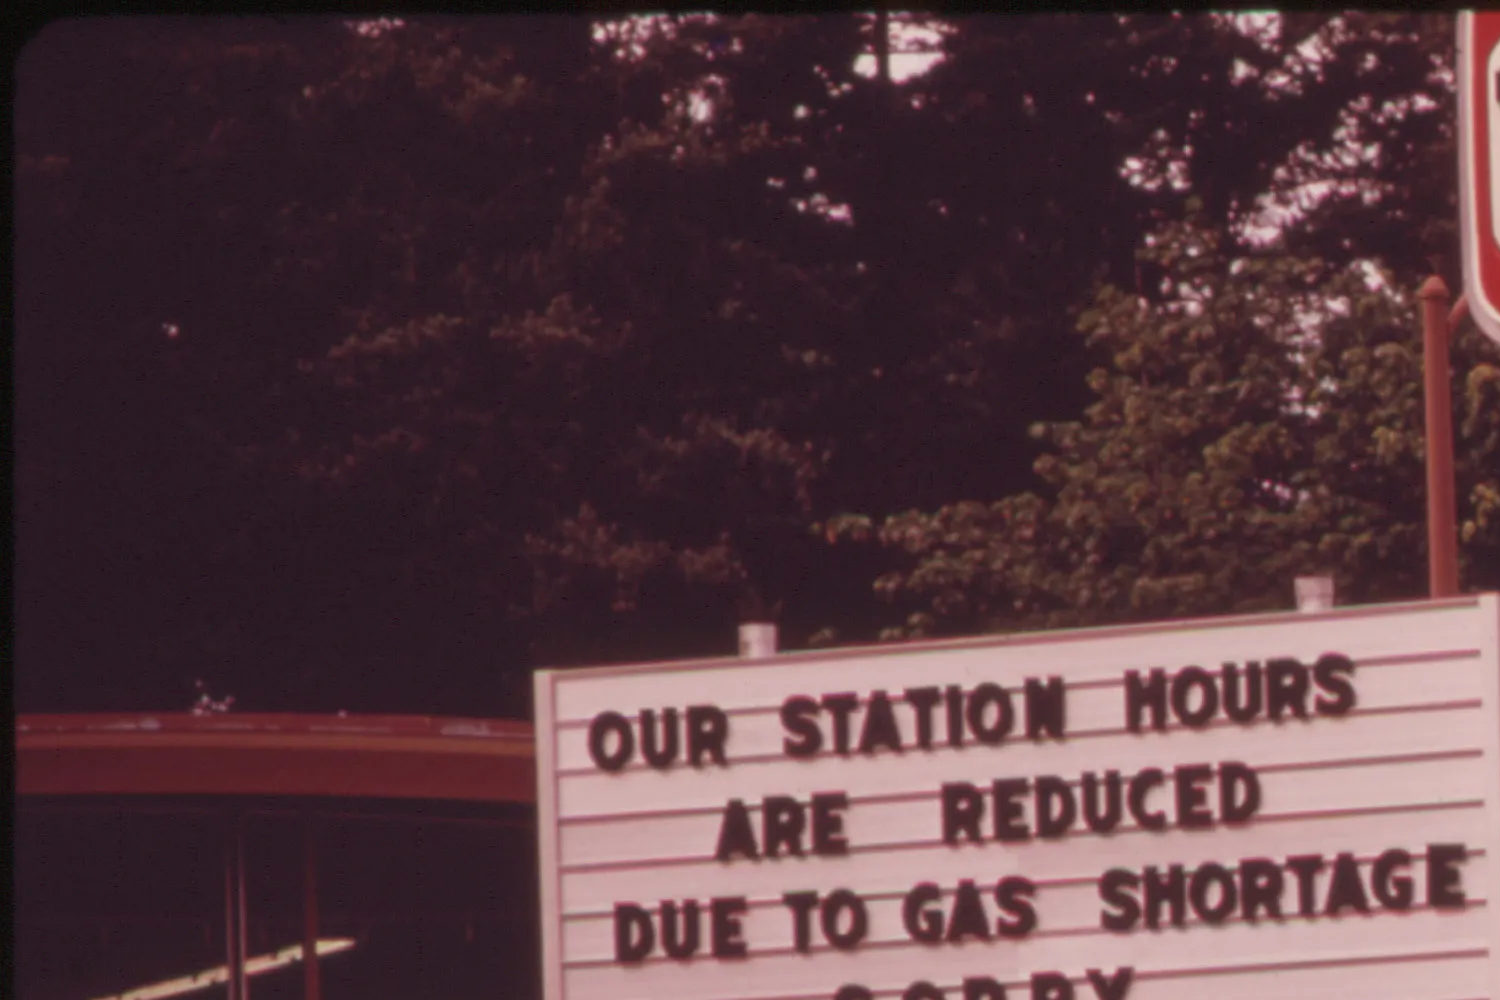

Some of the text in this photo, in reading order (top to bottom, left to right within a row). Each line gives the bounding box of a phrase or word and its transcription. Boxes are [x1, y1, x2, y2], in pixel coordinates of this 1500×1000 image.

[589, 652, 1356, 773] OUR STATION HOURS
[716, 762, 1261, 862] ARE REDUCED
[614, 843, 1467, 967] DUE TO GAS SHORTAGE
